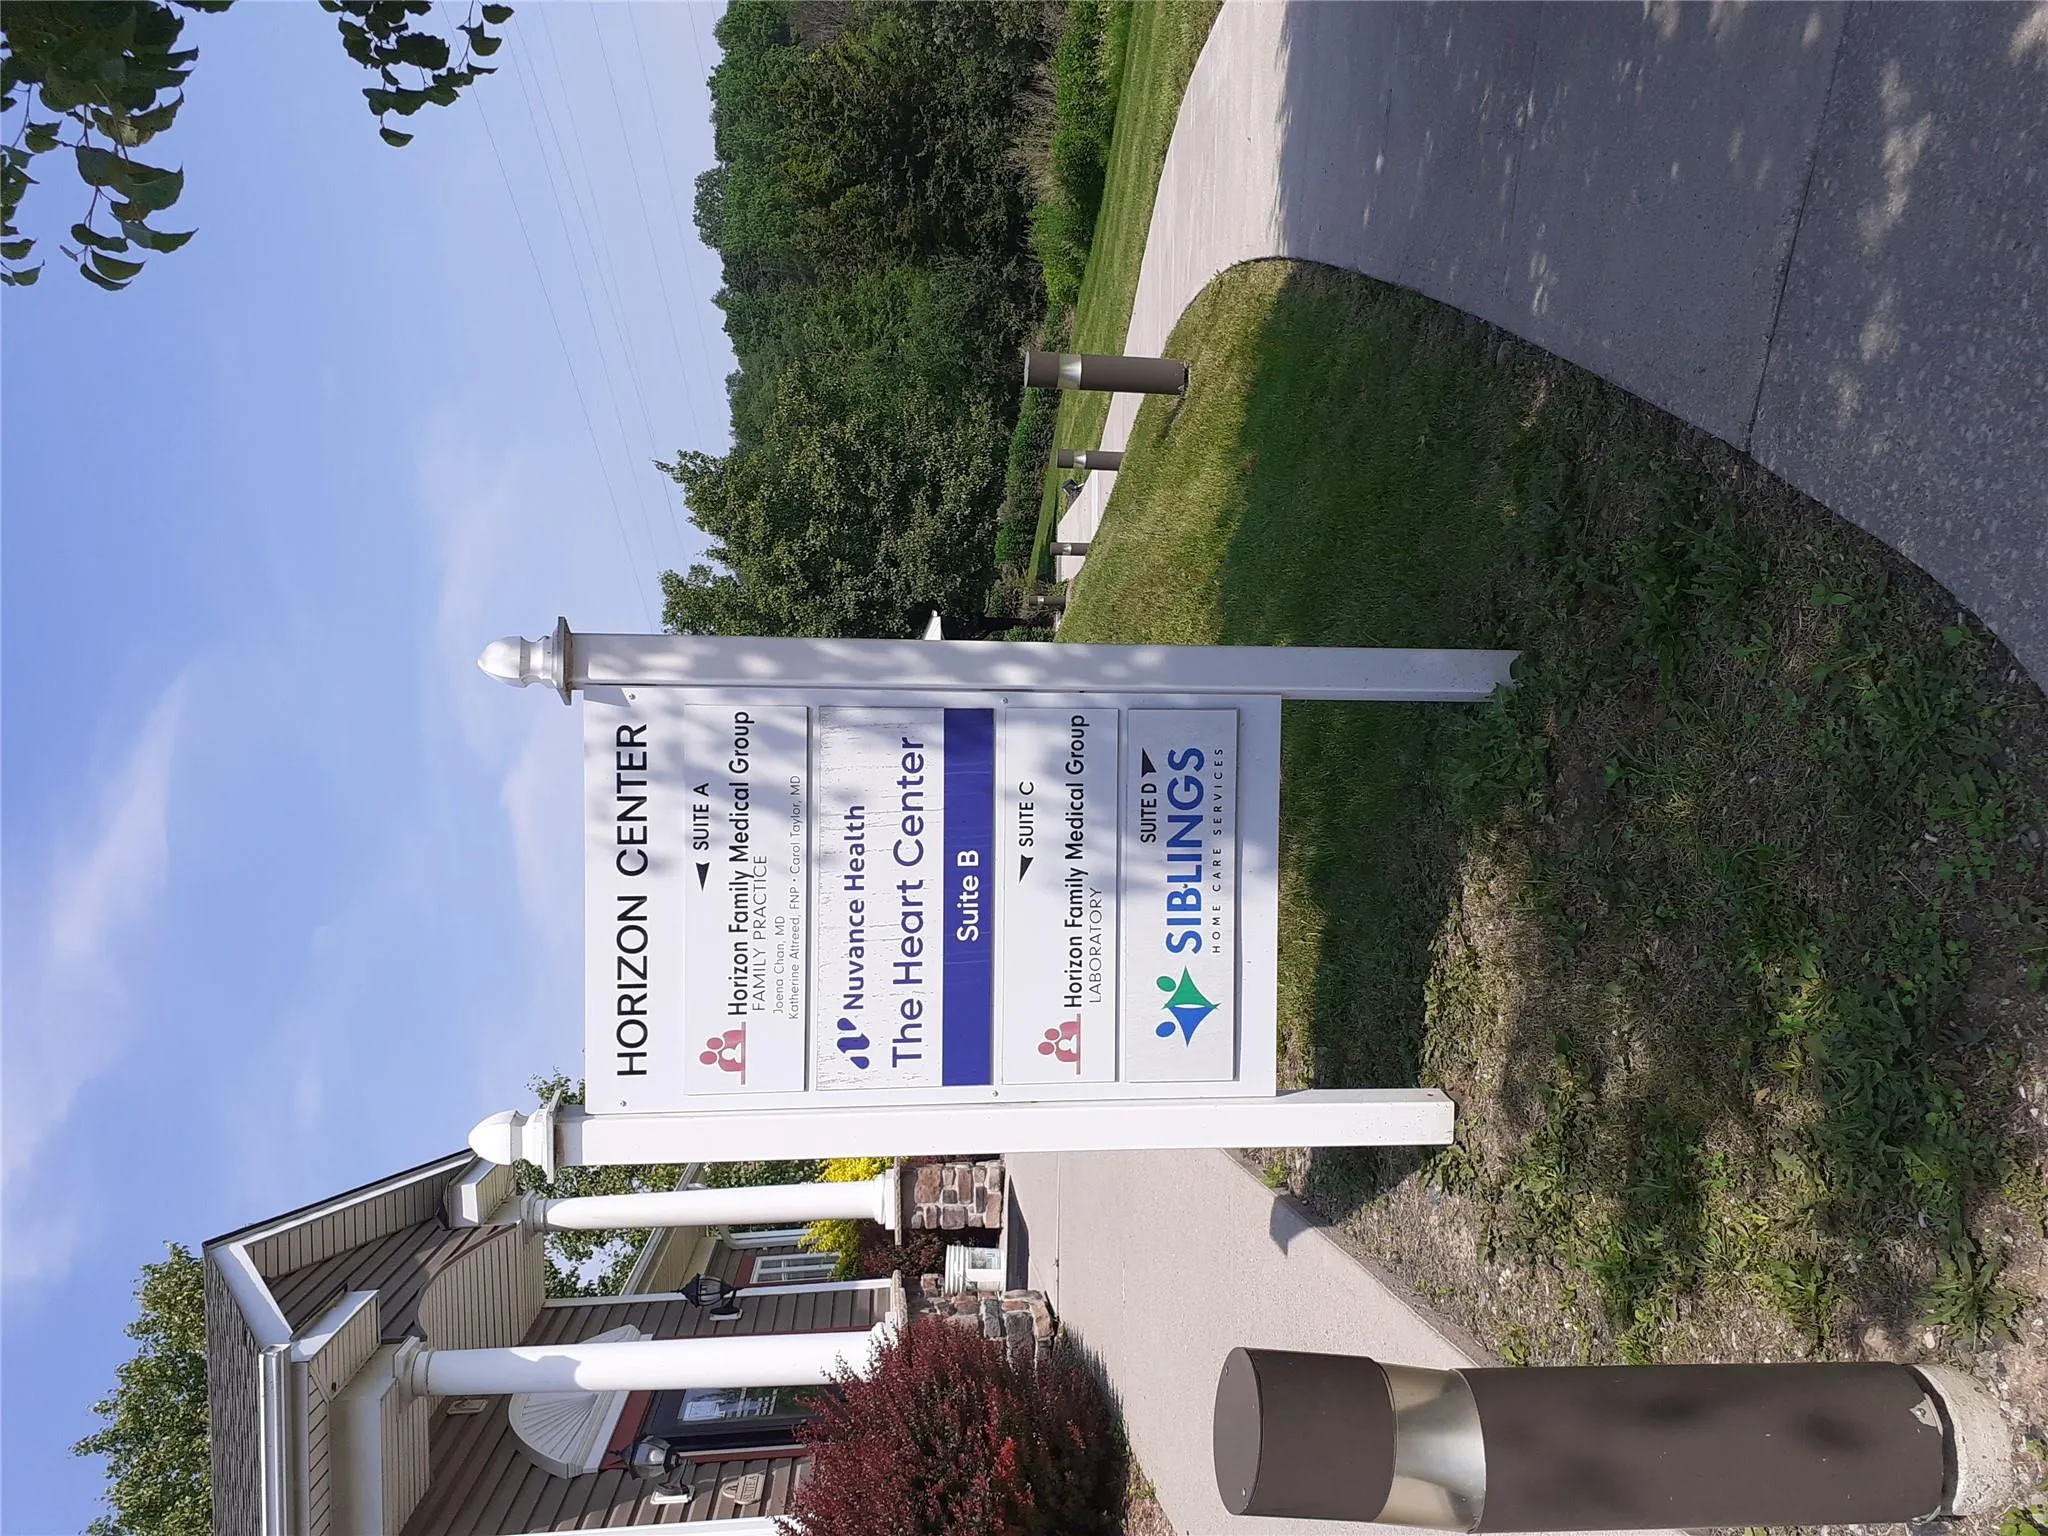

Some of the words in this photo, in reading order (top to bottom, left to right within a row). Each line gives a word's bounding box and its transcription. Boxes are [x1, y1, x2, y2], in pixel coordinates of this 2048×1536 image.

[729, 712, 754, 774] Group
[1066, 715, 1089, 774] Group
[616, 724, 648, 877] CENTER
[694, 783, 709, 797] A
[790, 776, 800, 795] MD
[894, 737, 924, 867] Center
[1019, 781, 1034, 796] C
[1142, 783, 1156, 794] D
[1213, 748, 1223, 835] SERVICES
[693, 804, 710, 850] SUITE
[729, 782, 750, 862] Medical
[790, 800, 803, 838] Taylor,
[844, 805, 865, 891] Health
[1018, 802, 1034, 847] SUITE
[1065, 783, 1084, 860] Medical
[1141, 798, 1157, 843] SUITE
[789, 842, 801, 874] Carol
[958, 850, 979, 867] B
[1166, 748, 1205, 954] SIBLINGS
[1212, 848, 1222, 892] CARE
[728, 870, 754, 933] Family
[753, 856, 767, 940] PRACTICE
[775, 916, 785, 936] MD
[790, 886, 800, 910] FNP
[957, 875, 979, 941] Suite
[1064, 867, 1088, 928] Family
[774, 940, 786, 975] Chan,
[789, 914, 801, 959] Attreed,
[844, 900, 865, 1010] Nuvance
[894, 880, 924, 984] Heart
[1089, 887, 1102, 1003] LABORATORY
[1212, 905, 1221, 954] HOME
[616, 895, 648, 1076] HORIZON
[728, 941, 749, 1015] Horizon
[753, 948, 766, 1011] FAMILY
[774, 978, 785, 1014] Joena
[789, 963, 800, 1019] Katherine
[1064, 936, 1083, 1008] Horizon
[892, 998, 923, 1068] The
